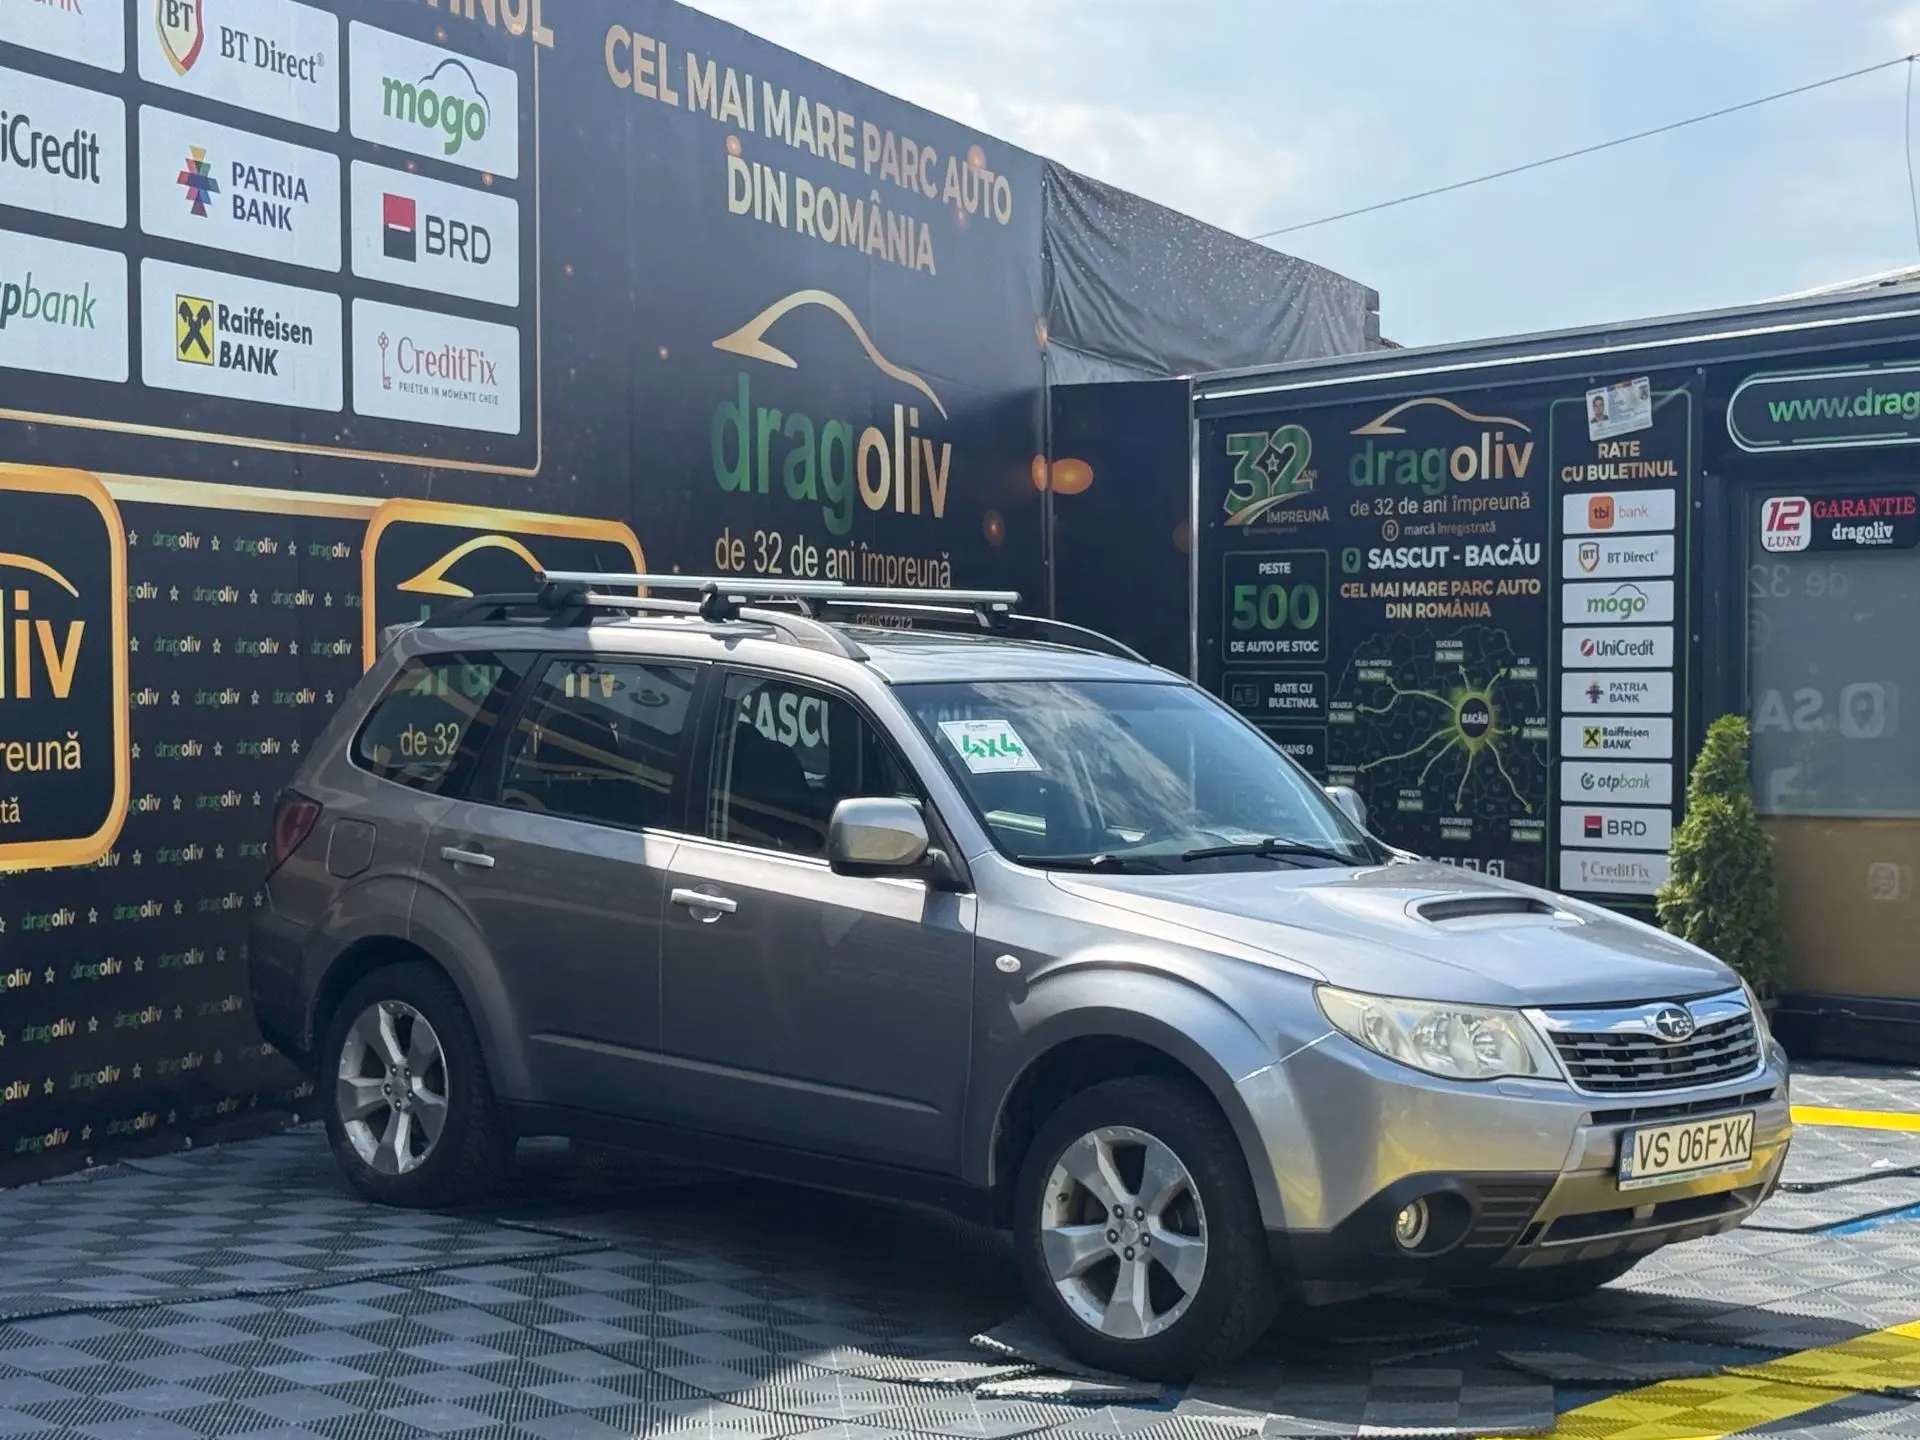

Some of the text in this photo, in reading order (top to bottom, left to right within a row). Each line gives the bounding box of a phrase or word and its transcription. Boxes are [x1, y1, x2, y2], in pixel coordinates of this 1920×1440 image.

[167, 0, 193, 32] BT
[220, 26, 248, 62] BT
[382, 76, 486, 155] mogo
[605, 24, 1012, 226] CEL MAI MARE PARC AUTO
[232, 161, 309, 203] PATRIA
[232, 194, 293, 231] BANK
[727, 154, 936, 276] DIN ROMÂNIA
[425, 214, 491, 265] BRD
[0, 272, 96, 329] pbank
[218, 304, 313, 345] Raiffeisen
[219, 341, 279, 376] BANK
[397, 336, 498, 386] CreditFix
[399, 381, 429, 395] PRIETEN
[442, 388, 477, 403] MOMENTE
[479, 393, 499, 405] CHEIE
[710, 372, 952, 537] dragoliv
[1598, 440, 1640, 459] RATE
[1223, 424, 1313, 517] 32
[1349, 432, 1535, 495] dragoliv
[1561, 460, 1678, 482] CU BULETINUL
[1350, 491, 1531, 517] de 32 de ani împreună
[1618, 504, 1649, 519] bank
[1813, 496, 1917, 519] GARANTIE
[1766, 501, 1806, 532] 12
[1404, 523, 1435, 536] marcă
[1832, 521, 1894, 545] dragoliv
[152, 530, 200, 552] dragoliv
[233, 536, 278, 556] dragoliv
[1368, 546, 1449, 570] SASCUT
[1465, 537, 1541, 567] BACĂU
[1767, 536, 1802, 548] LUNI
[715, 526, 951, 589] de 32 de ani împreună
[1582, 549, 1595, 560] BT
[1607, 552, 1621, 563] BT
[1259, 562, 1291, 574] PESTE
[1340, 578, 1541, 599] CEL MAI MARE PARC AUTO
[1232, 582, 1320, 631] 500
[1385, 599, 1491, 619] DIN ROMÂNIA
[1587, 597, 1646, 620] mogo
[153, 635, 201, 656] dragoliv
[235, 637, 280, 658] dragoliv
[1231, 640, 1320, 653] DE AUTO PE STOC
[1596, 639, 1654, 656] UniCredit
[1274, 683, 1313, 694] RATE CU
[1609, 682, 1648, 692] PATRIA
[1609, 693, 1640, 703] BANK
[1268, 698, 1319, 708] BULETINUL
[400, 723, 459, 756] de 32
[1602, 726, 1650, 738] Raiffeisen
[154, 737, 280, 760] dragoliv dragoliv
[1278, 745, 1307, 756] VANS
[1602, 740, 1631, 750] BANK
[1597, 772, 1651, 792] otpbank
[1607, 820, 1647, 836] BRD
[1590, 861, 1650, 878] CreditFix
[22, 908, 76, 931] dragoliv
[113, 900, 163, 922] dragoliv
[70, 957, 122, 981] dragoliv
[22, 1017, 76, 1043] dragoliv
[1639, 1130, 1671, 1170] VS
